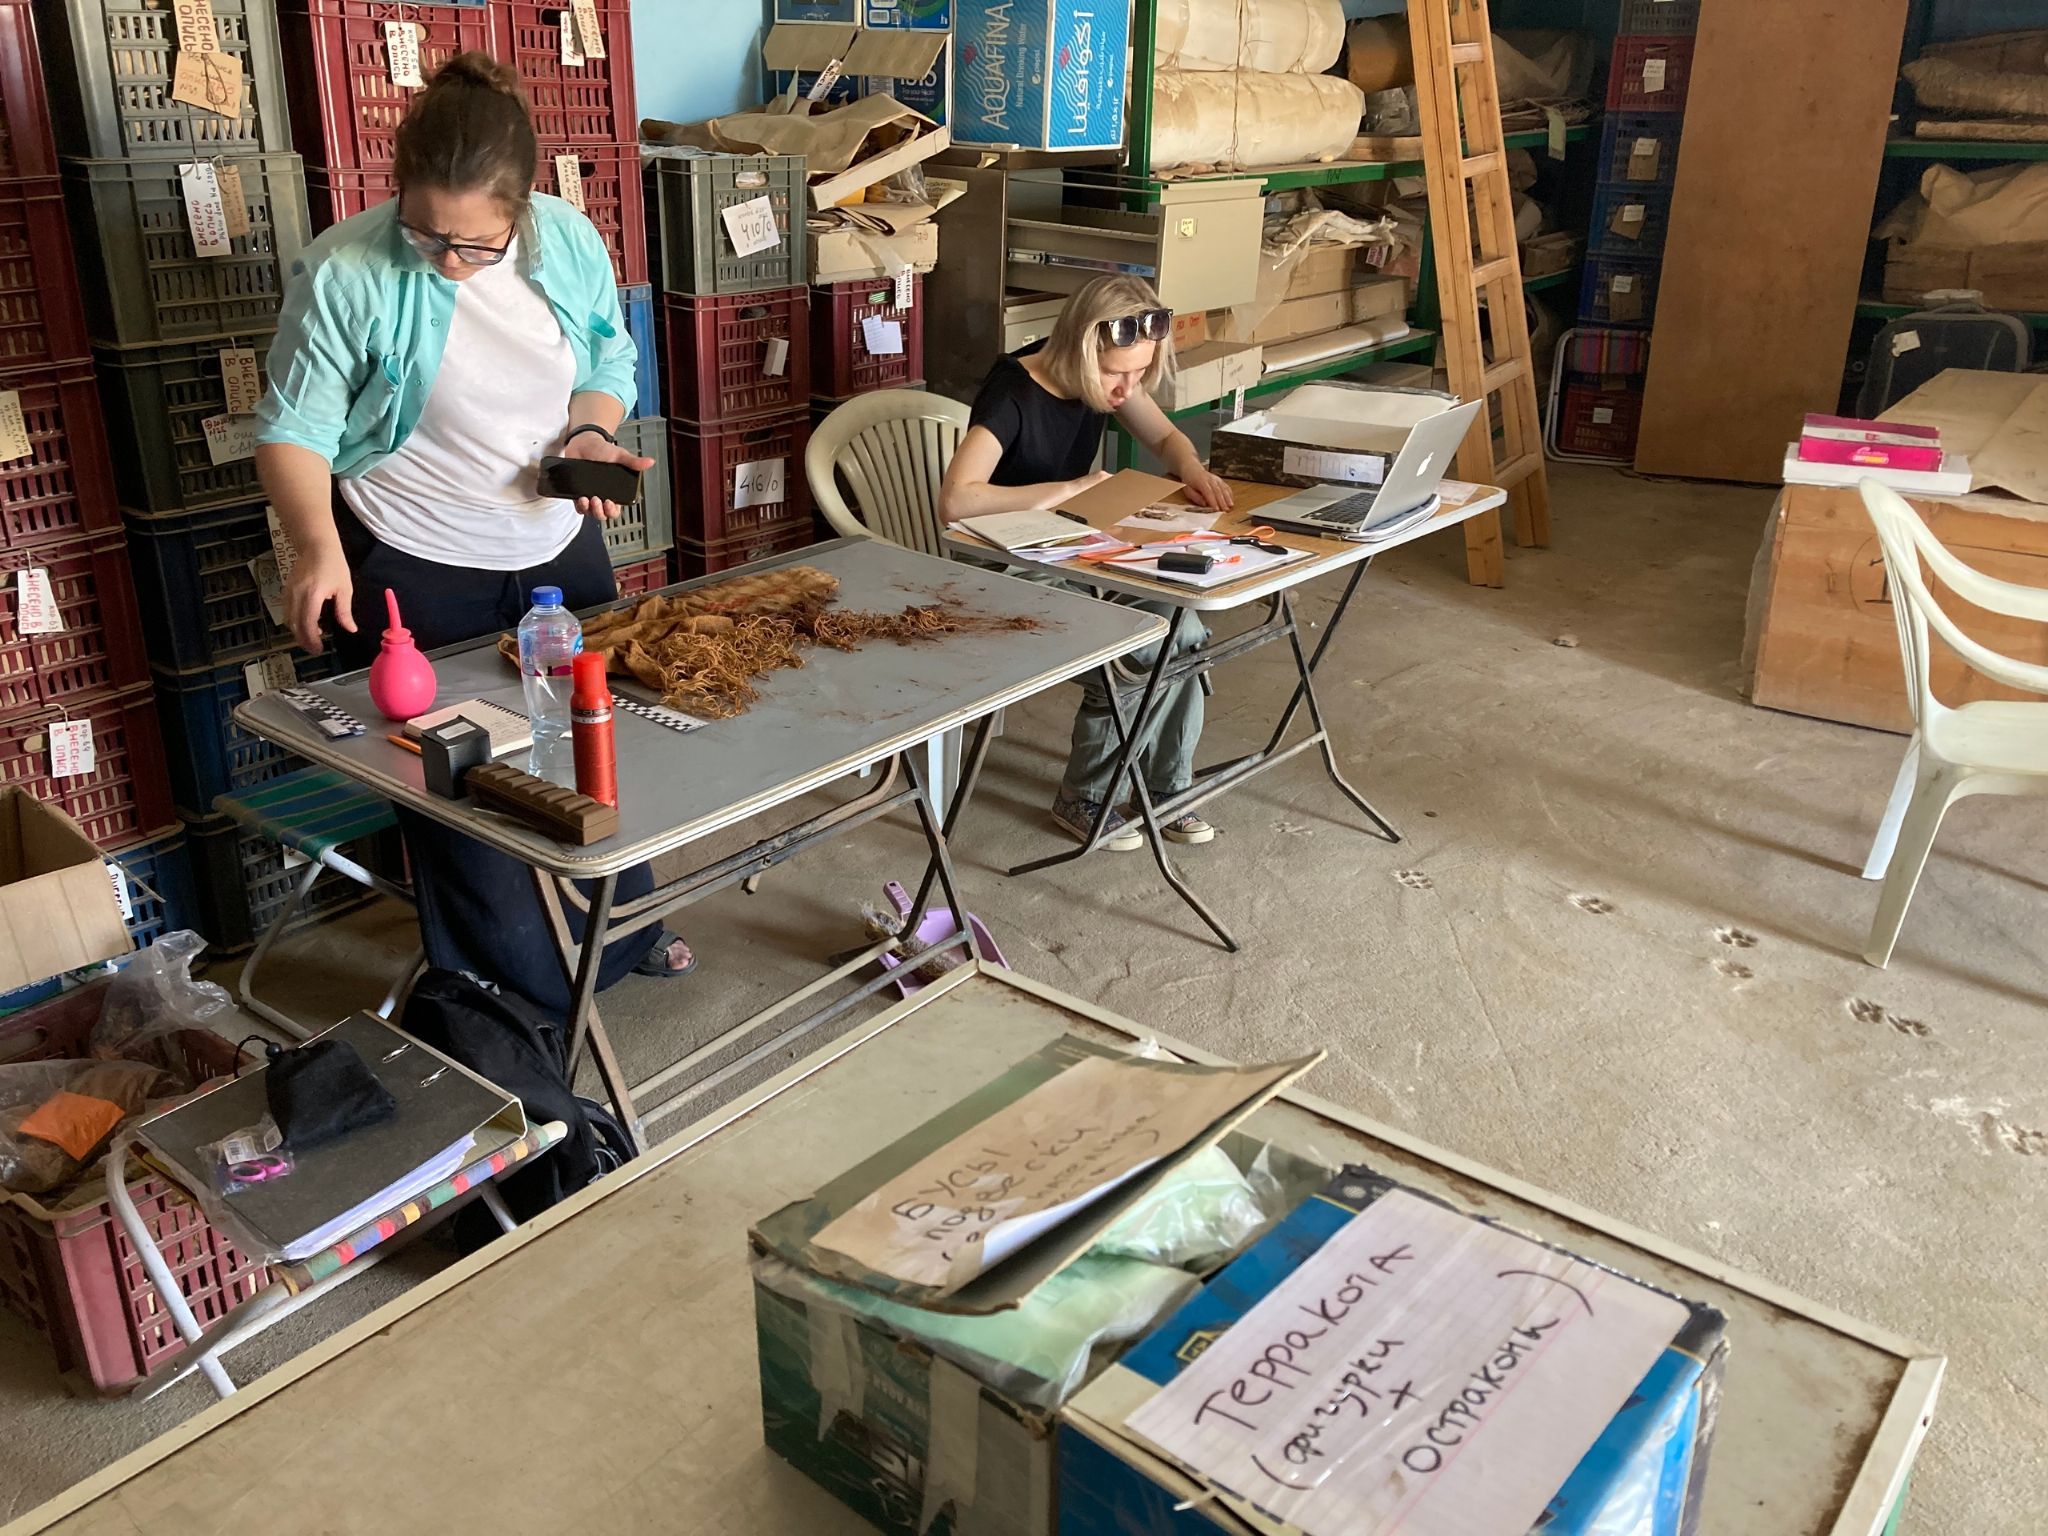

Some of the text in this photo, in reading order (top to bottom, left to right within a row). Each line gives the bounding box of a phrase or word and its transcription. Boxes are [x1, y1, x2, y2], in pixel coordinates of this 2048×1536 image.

[981, 1, 1013, 129] AQUAFINA
[1015, 22, 1028, 107] Natural Drinking Water
[1067, 11, 1095, 134] أكوافينا
[740, 471, 779, 496] 416/0
